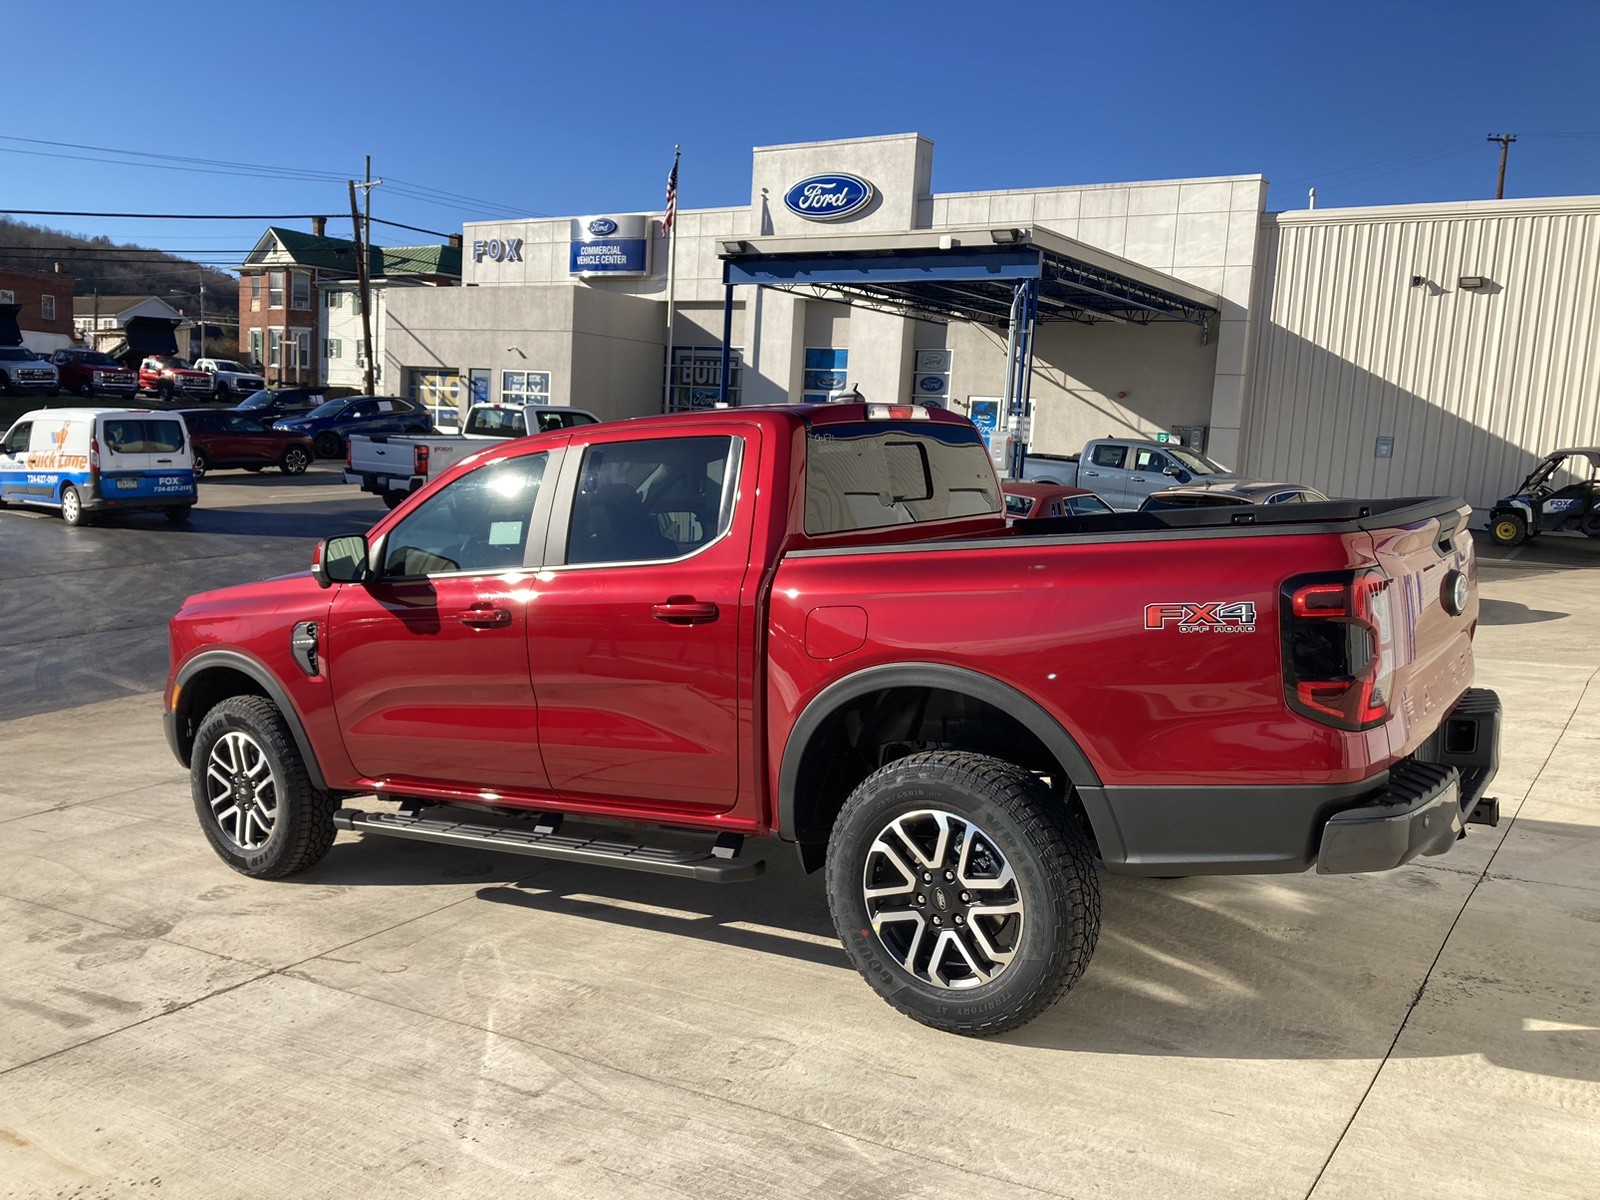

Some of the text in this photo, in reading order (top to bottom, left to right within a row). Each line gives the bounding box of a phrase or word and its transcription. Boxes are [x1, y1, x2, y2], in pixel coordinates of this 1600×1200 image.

[799, 183, 849, 209] Ford
[591, 221, 610, 232] Ford
[473, 239, 518, 260] FOX
[581, 245, 621, 255] COMMERCIAL
[577, 255, 627, 265] VEHICLE CENTER
[159, 477, 178, 485] FOX
[1144, 602, 1256, 629] FX4
[1214, 625, 1255, 633] ROAD
